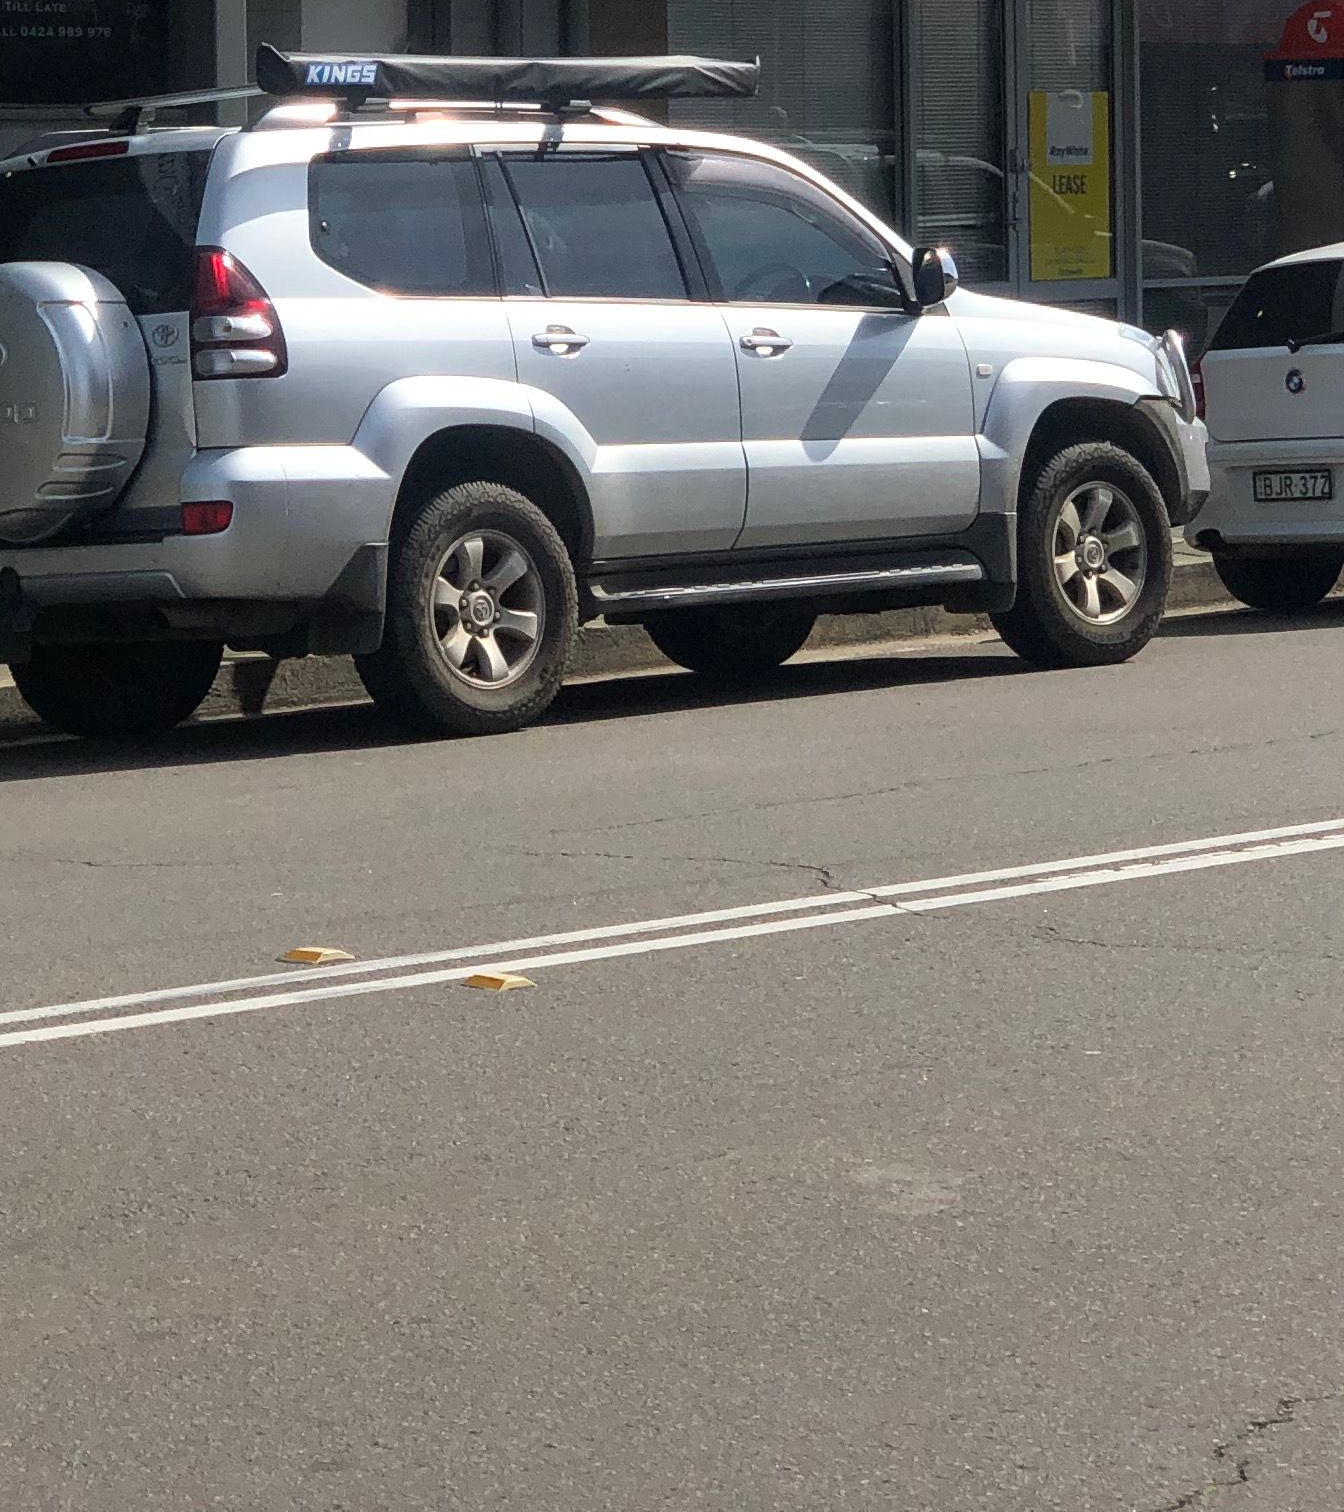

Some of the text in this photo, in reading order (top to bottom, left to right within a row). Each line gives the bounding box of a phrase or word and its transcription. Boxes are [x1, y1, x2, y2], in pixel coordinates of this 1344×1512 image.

[306, 62, 379, 85] KINGS
[1284, 63, 1325, 76] Telstra
[1052, 174, 1088, 195] LEASE
